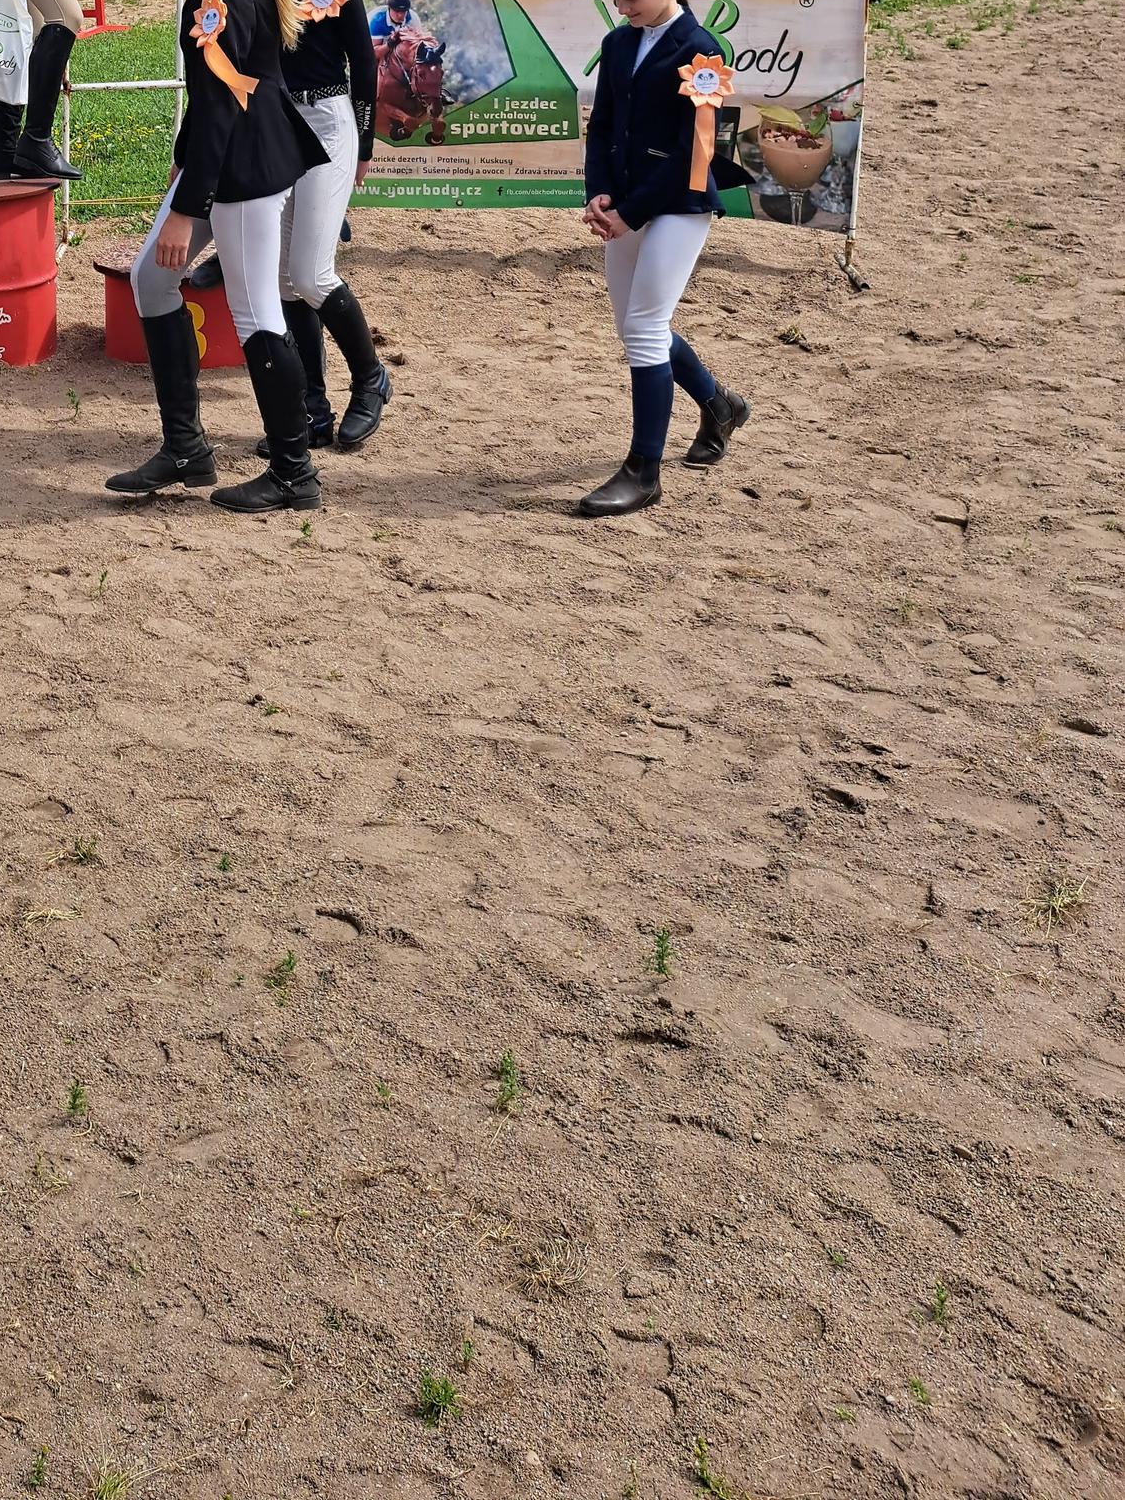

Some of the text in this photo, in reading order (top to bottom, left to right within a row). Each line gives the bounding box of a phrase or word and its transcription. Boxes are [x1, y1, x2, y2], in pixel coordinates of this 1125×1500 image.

[493, 97, 558, 112] I jezdec
[363, 103, 372, 130] POWER.
[469, 111, 537, 122] je vrcholový
[450, 120, 569, 138] sportovec!
[372, 155, 514, 166] orické dezerty Proteiny Kuskusy
[367, 166, 386, 174] rické
[422, 166, 451, 174] Sušené
[452, 166, 474, 176] plody
[514, 167, 542, 176] Zdravá
[543, 168, 568, 176] strava
[354, 183, 482, 199] ww.yourbody.cz
